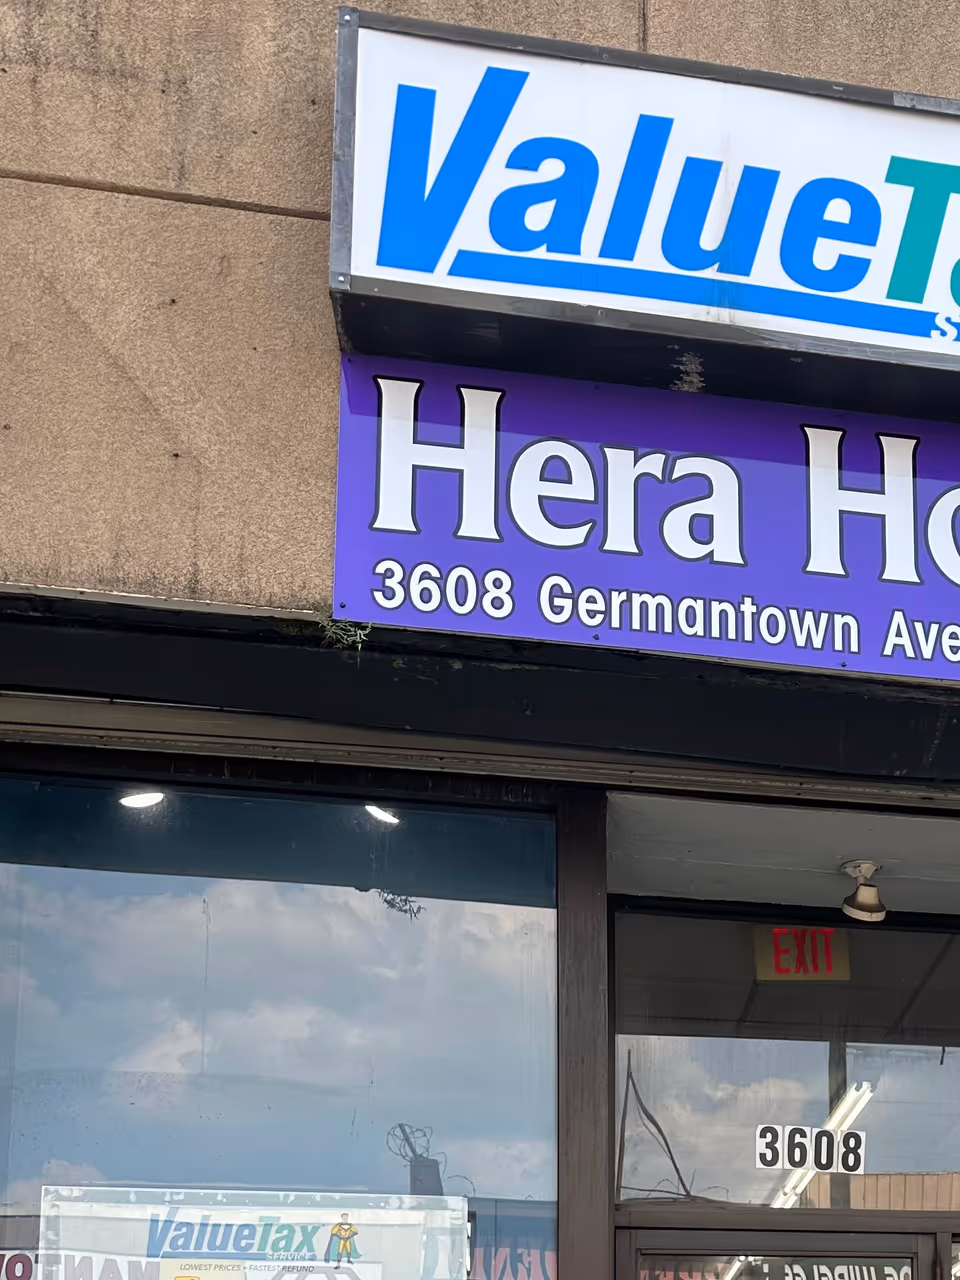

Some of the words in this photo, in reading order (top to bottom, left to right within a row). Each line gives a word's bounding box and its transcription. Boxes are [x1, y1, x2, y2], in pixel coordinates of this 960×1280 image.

[369, 375, 748, 566] Hera
[371, 559, 515, 619] 3608
[538, 573, 861, 655] Germantown
[772, 928, 836, 975] EXIT
[757, 1125, 863, 1173] 3608
[180, 1263, 213, 1272] LOWEST
[213, 1263, 241, 1272] PRICES
[249, 1264, 281, 1272] FASTEST
[281, 1265, 315, 1273] REFUND
[265, 1251, 312, 1261] SERVICE
